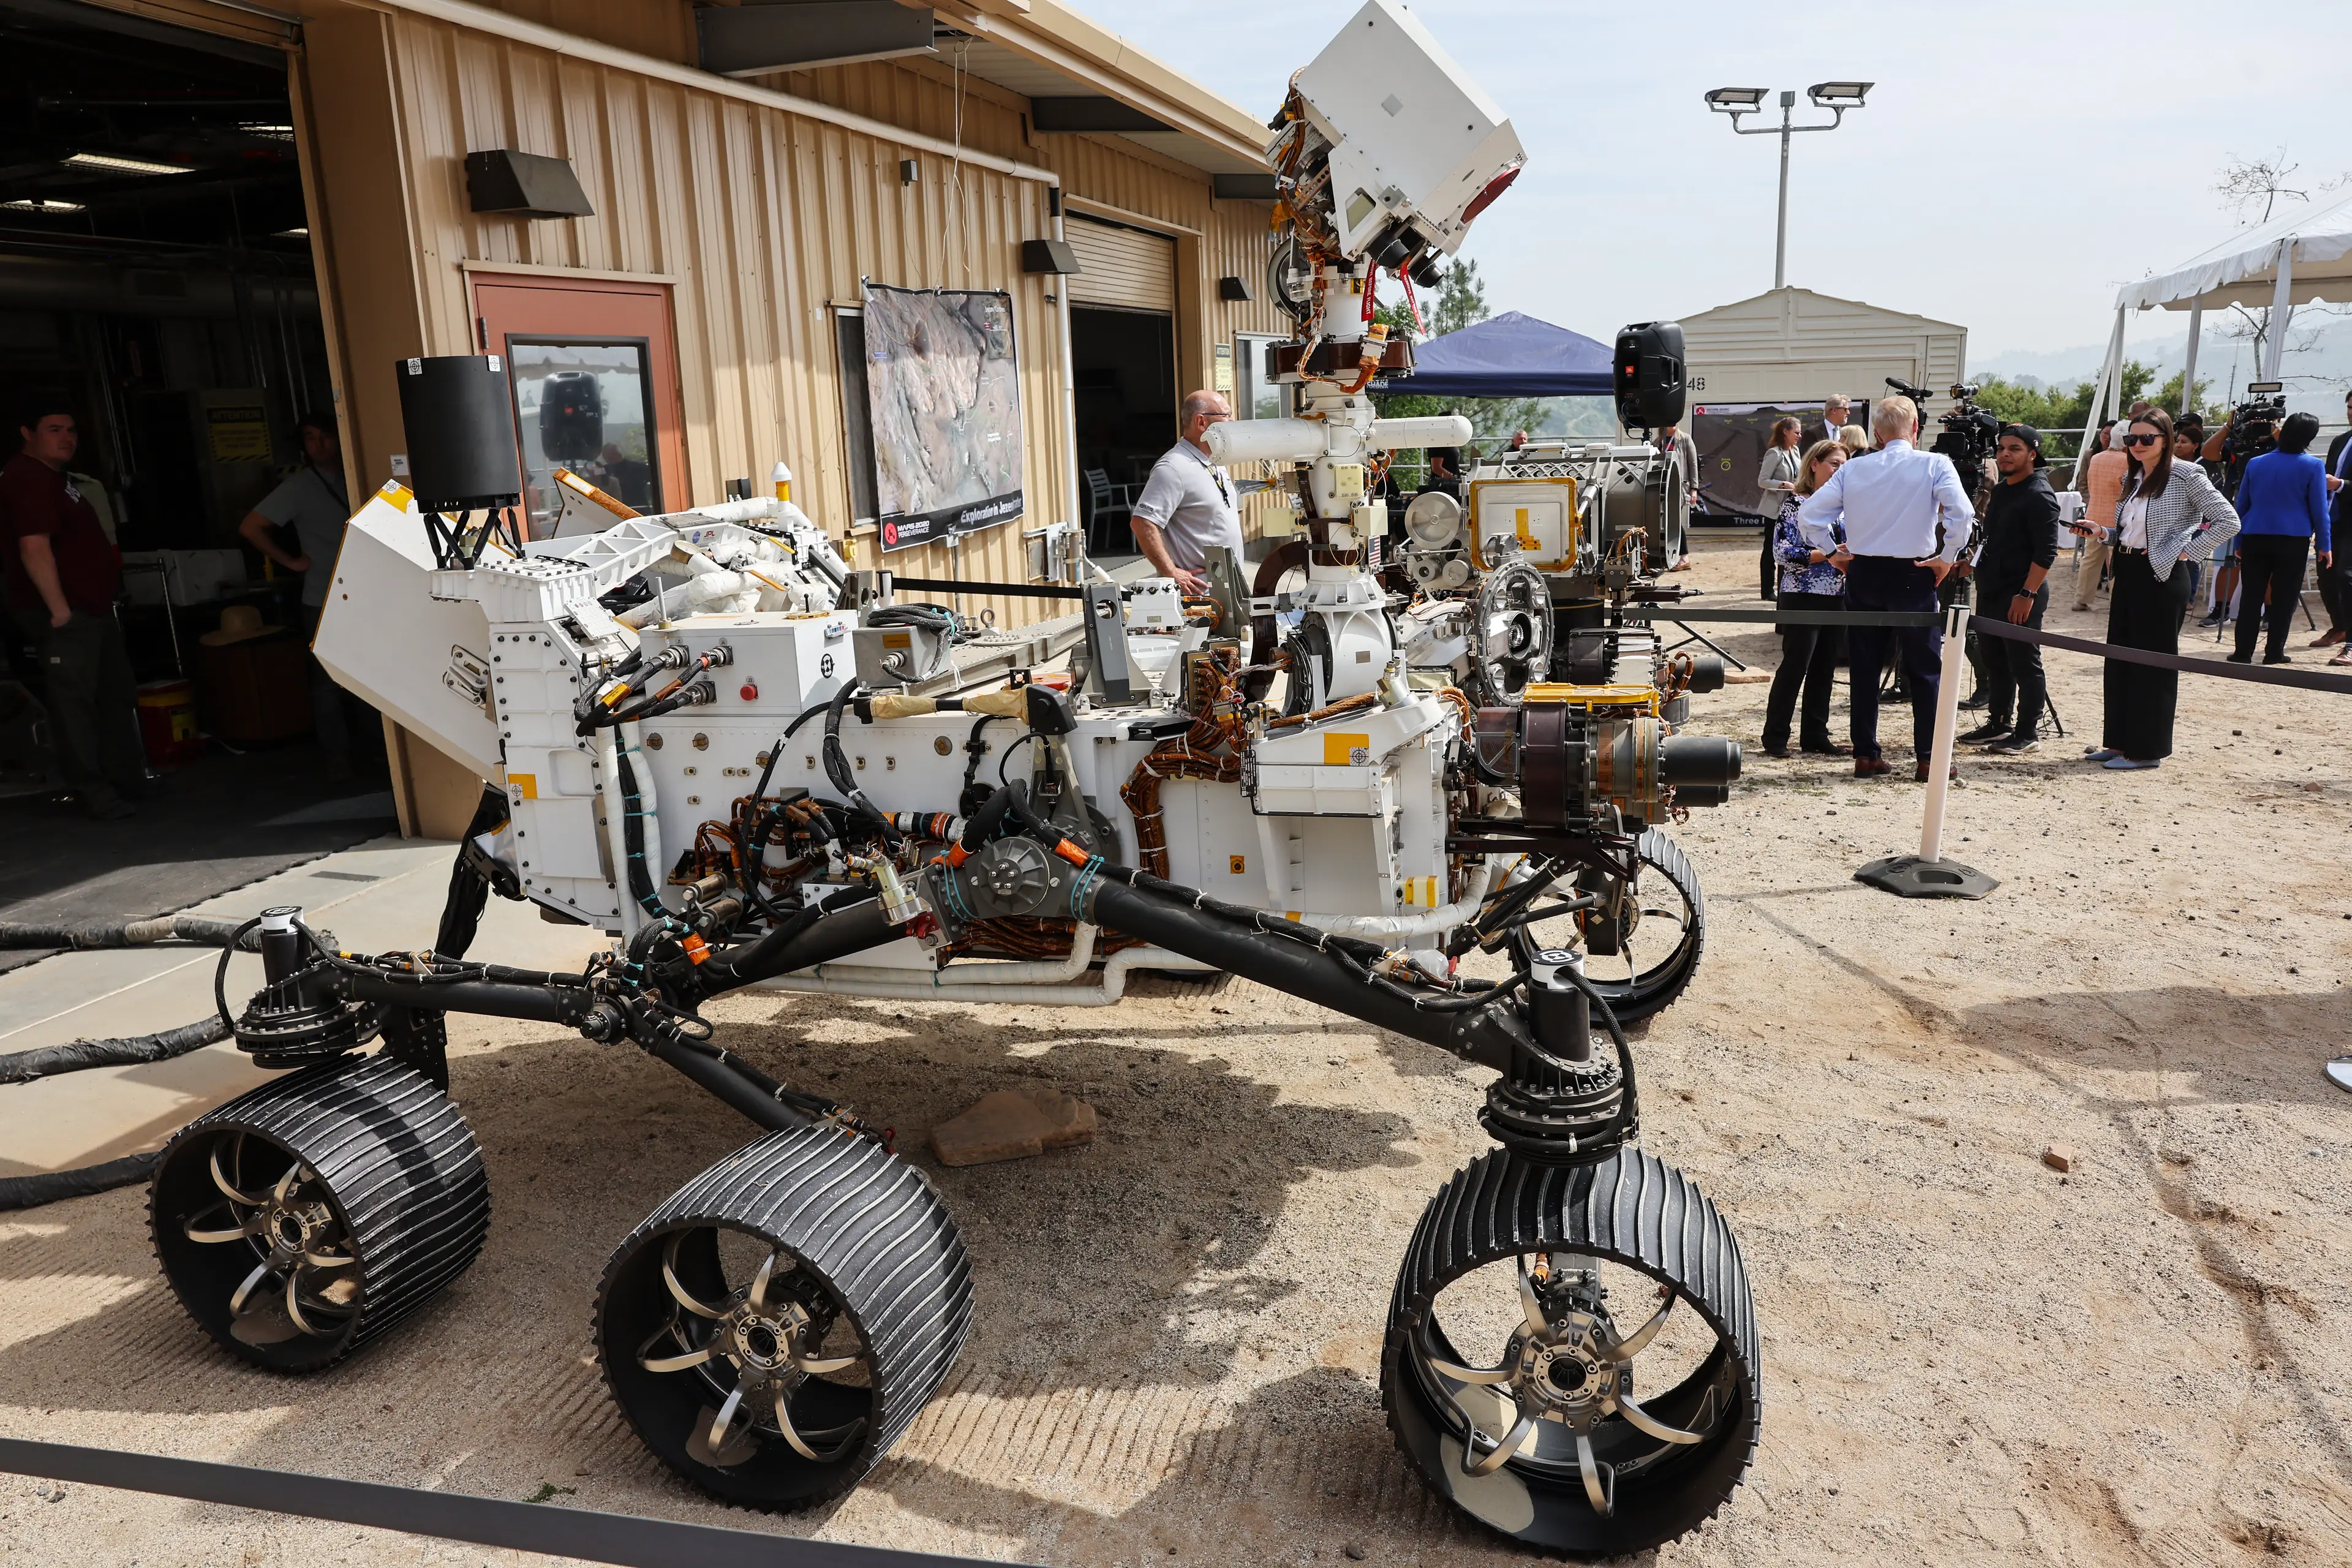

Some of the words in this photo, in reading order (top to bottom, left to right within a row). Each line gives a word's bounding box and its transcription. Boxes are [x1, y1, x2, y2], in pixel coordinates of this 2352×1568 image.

[1686, 377, 1705, 391] 48
[960, 505, 993, 525] Exploration
[993, 503, 998, 516] in
[897, 523, 914, 532] MARS
[915, 520, 930, 529] 2020
[898, 526, 930, 538] PERSEVERANCE
